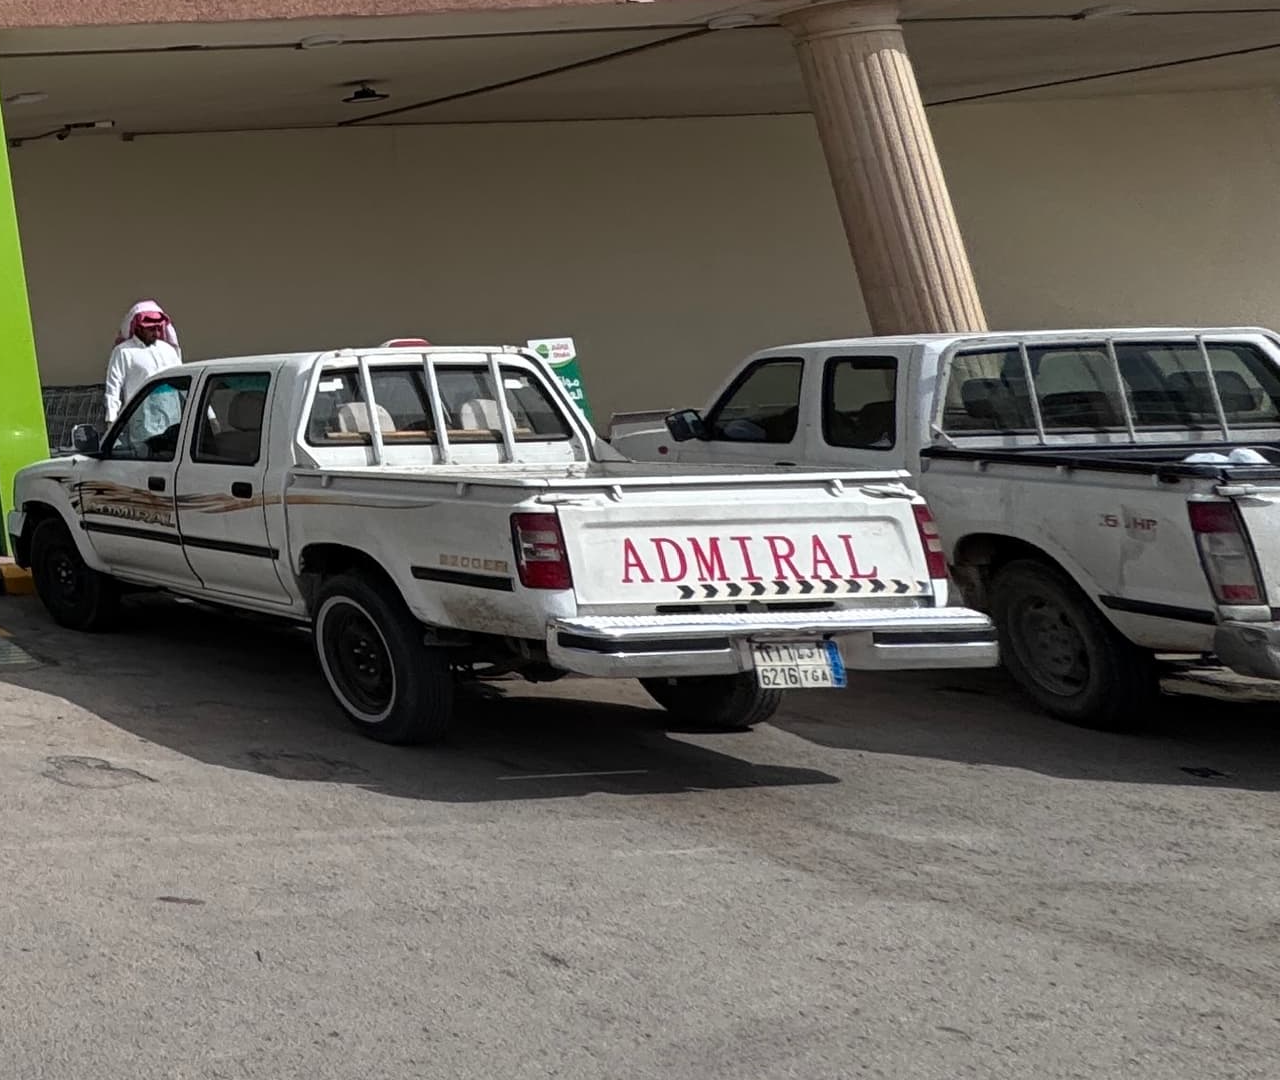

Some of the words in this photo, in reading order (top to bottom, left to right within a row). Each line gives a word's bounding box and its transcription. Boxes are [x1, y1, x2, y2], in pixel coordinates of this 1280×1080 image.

[622, 534, 878, 583] ADMIRAL
[761, 667, 798, 686] 6216
[801, 670, 829, 682] TGA
